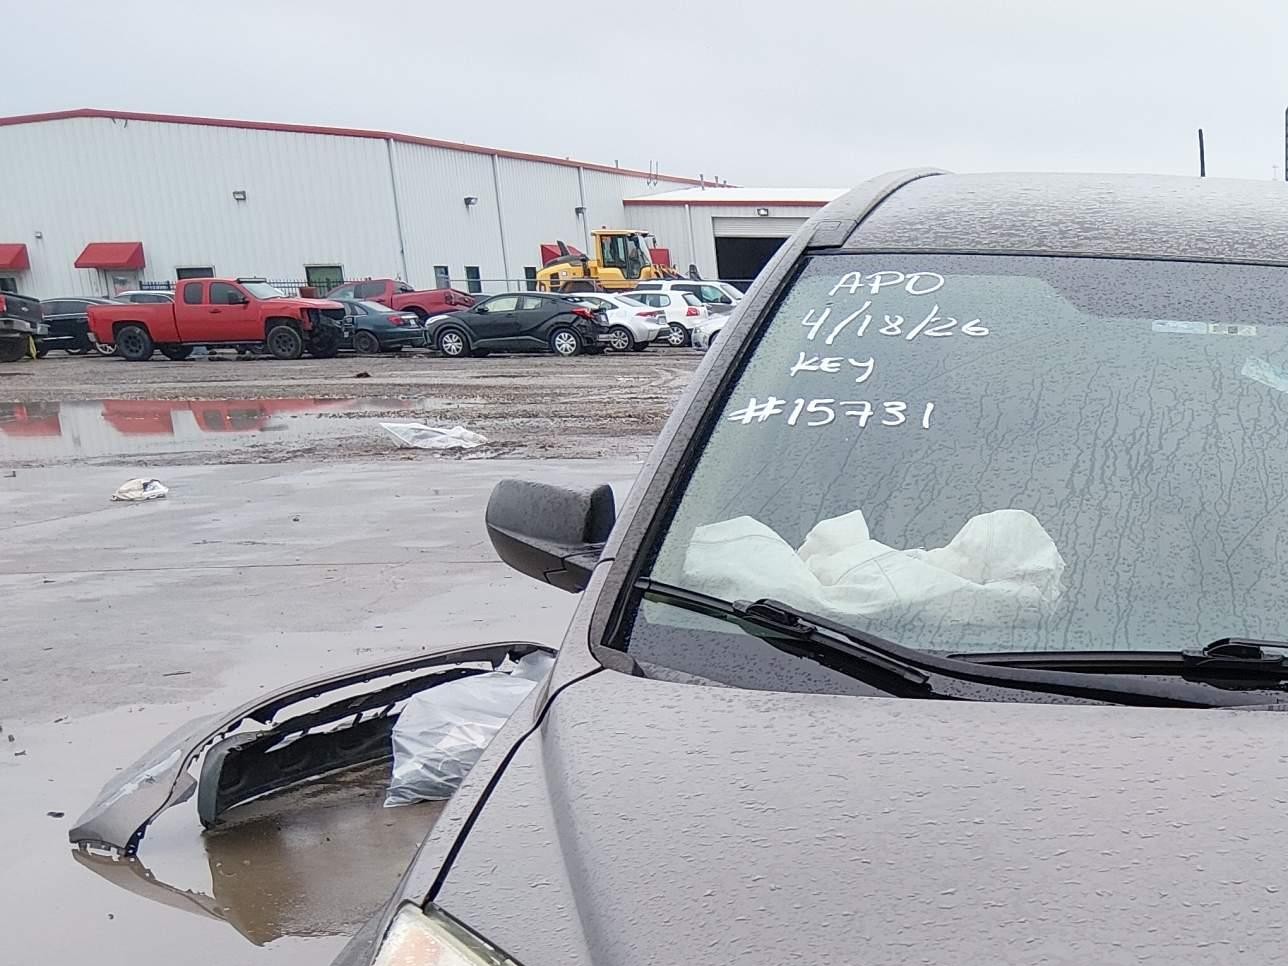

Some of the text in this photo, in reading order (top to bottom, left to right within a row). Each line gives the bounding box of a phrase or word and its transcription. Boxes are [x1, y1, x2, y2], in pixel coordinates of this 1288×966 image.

[801, 301, 990, 345] 4/18/26
[790, 351, 875, 383] KEY
[727, 396, 935, 429] #15731
